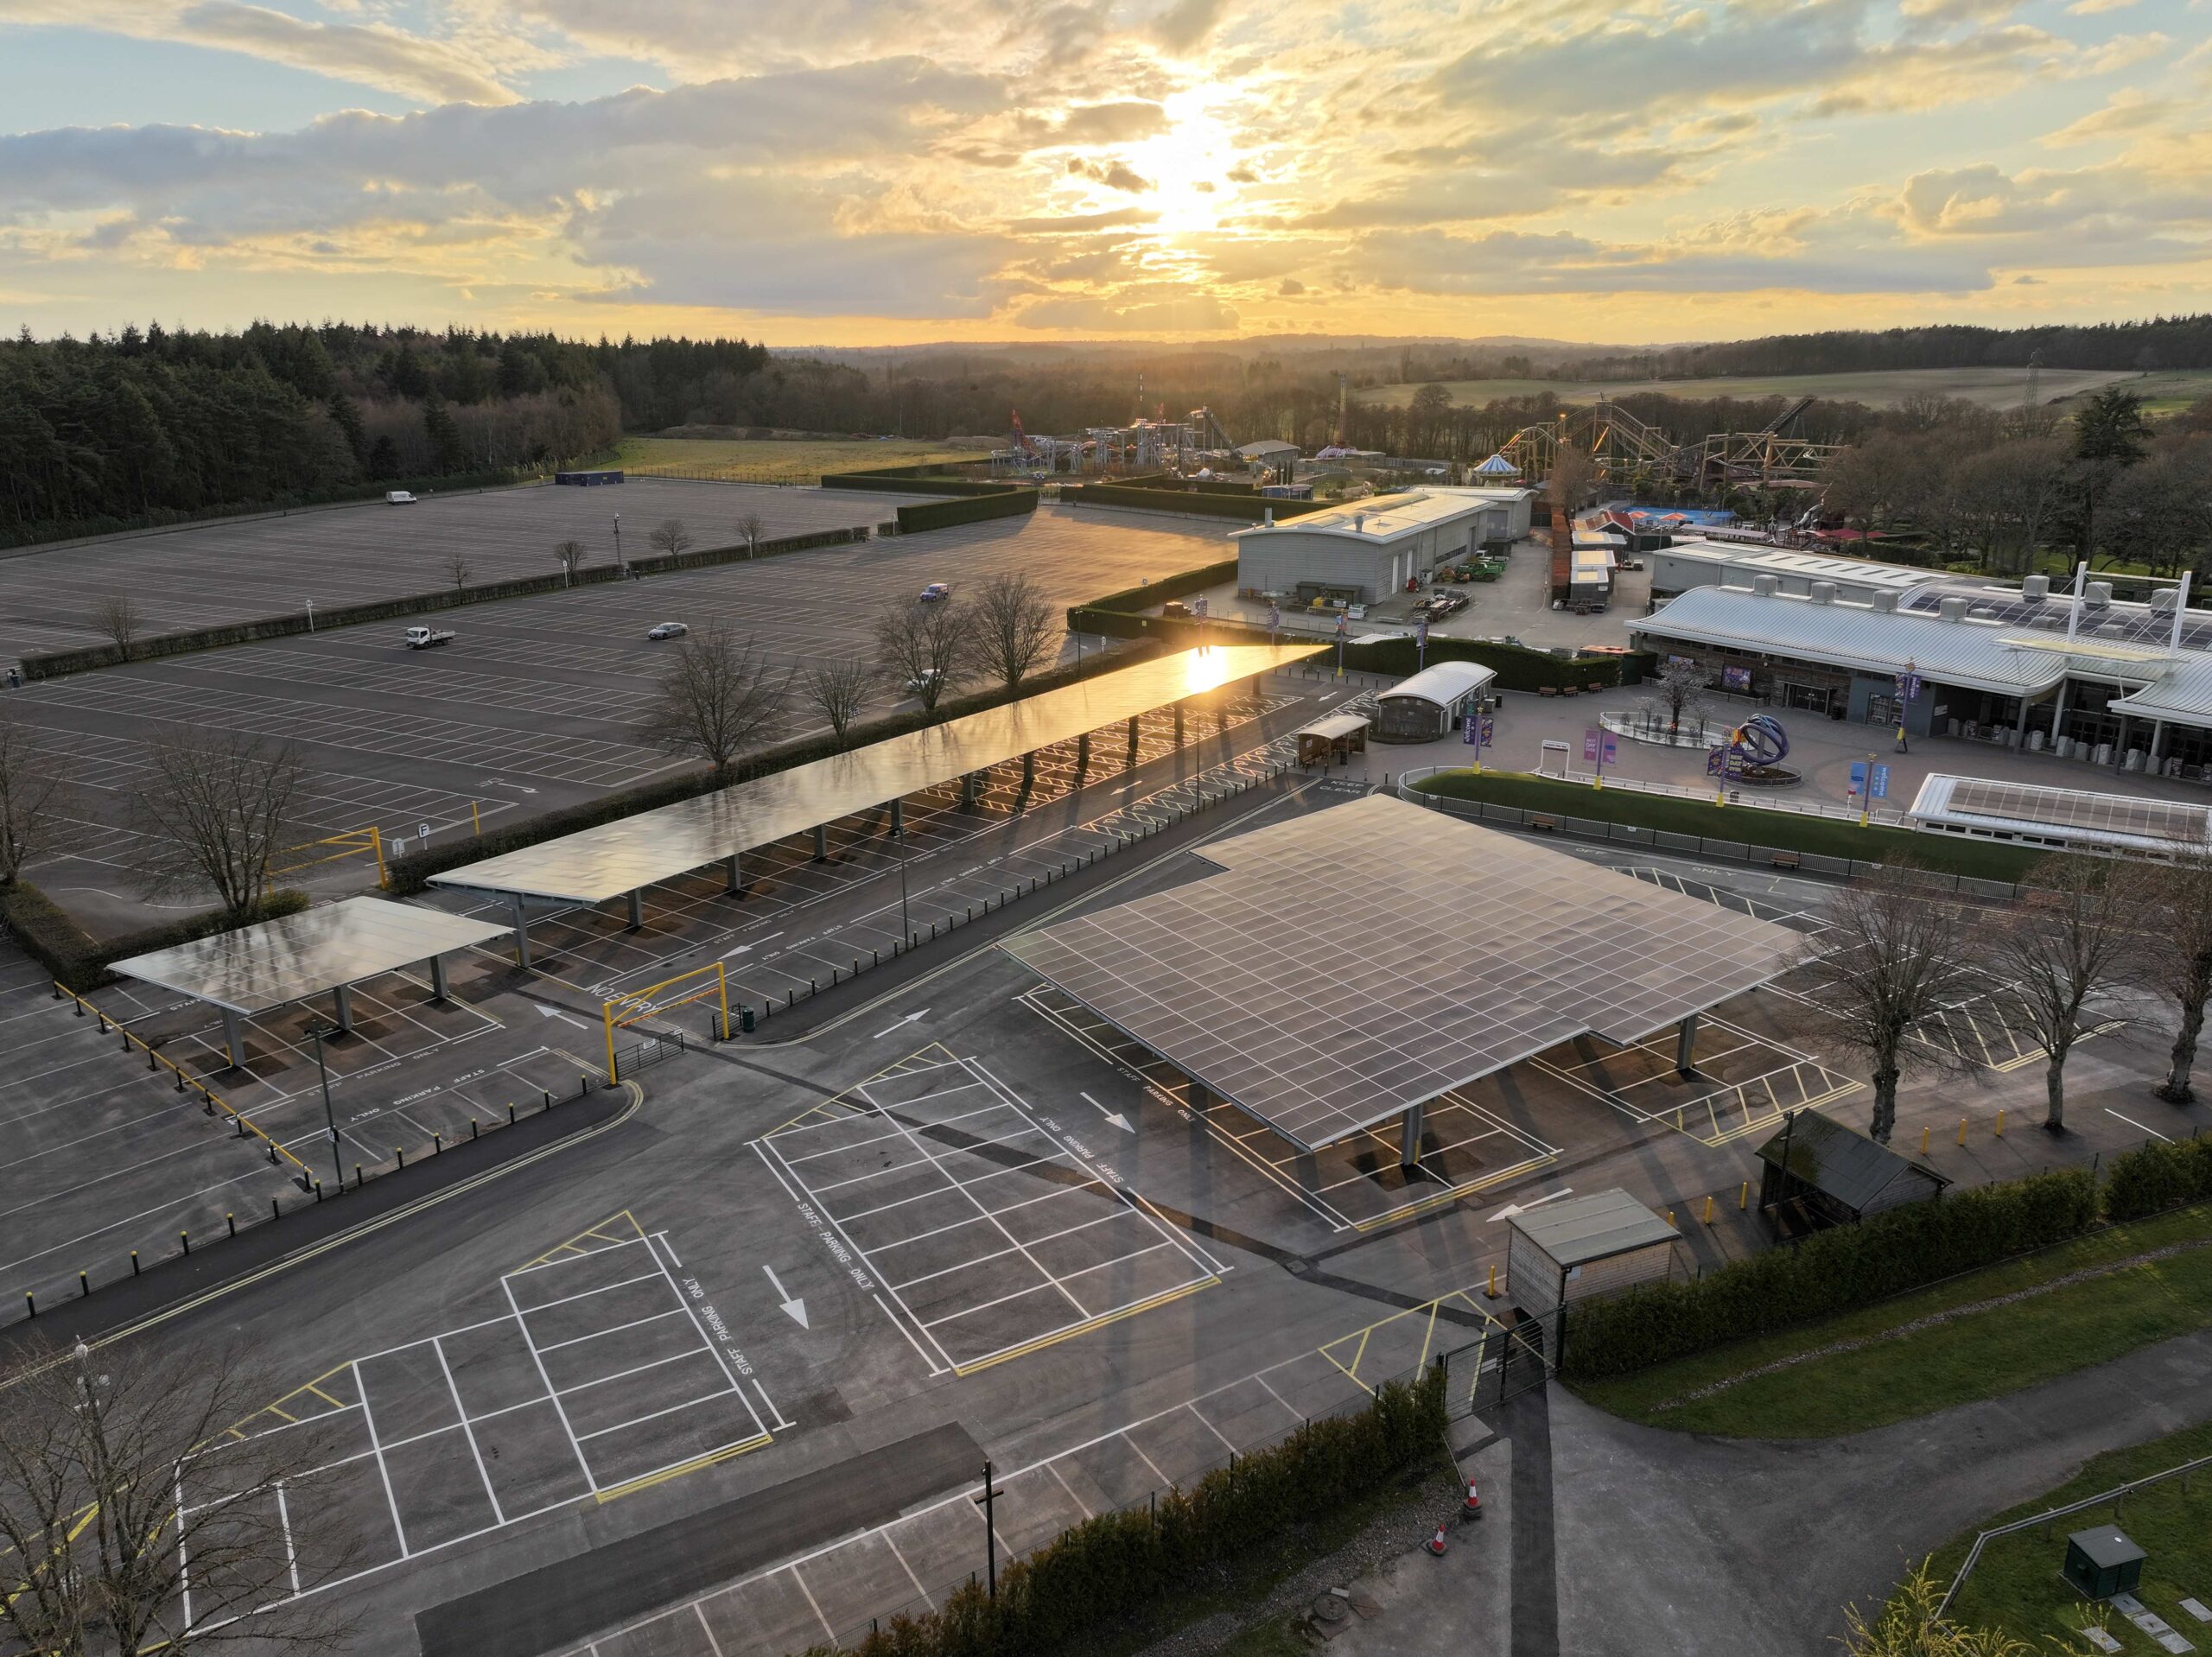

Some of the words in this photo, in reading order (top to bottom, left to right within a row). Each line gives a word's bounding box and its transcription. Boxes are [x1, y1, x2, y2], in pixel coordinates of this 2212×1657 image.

[1878, 767, 1887, 797] welcome
[421, 825, 428, 835] F
[1575, 848, 1607, 857] OFF
[1692, 867, 1737, 877] ONLY
[590, 984, 614, 997] NO
[604, 991, 662, 1014] ENTRY
[356, 1062, 402, 1079] PARKING
[413, 1047, 440, 1060] ONLY
[454, 1069, 485, 1083] STAFF
[393, 1085, 441, 1106] PARKING
[1116, 1067, 1141, 1082] STAFF
[1143, 1085, 1173, 1106] PARKING
[1178, 1109, 1197, 1122] ONLY
[350, 1108, 380, 1122] ONLY
[1039, 1117, 1061, 1132] ONLY
[1063, 1135, 1095, 1159] PARKING
[1096, 1164, 1124, 1183] STAFF
[798, 1203, 823, 1228] STAFF
[819, 1231, 852, 1263] PARKING
[849, 1268, 875, 1291] ONLY
[682, 1278, 704, 1298] ONLY
[702, 1305, 732, 1341] PARKING
[727, 1348, 753, 1375] STAFF
